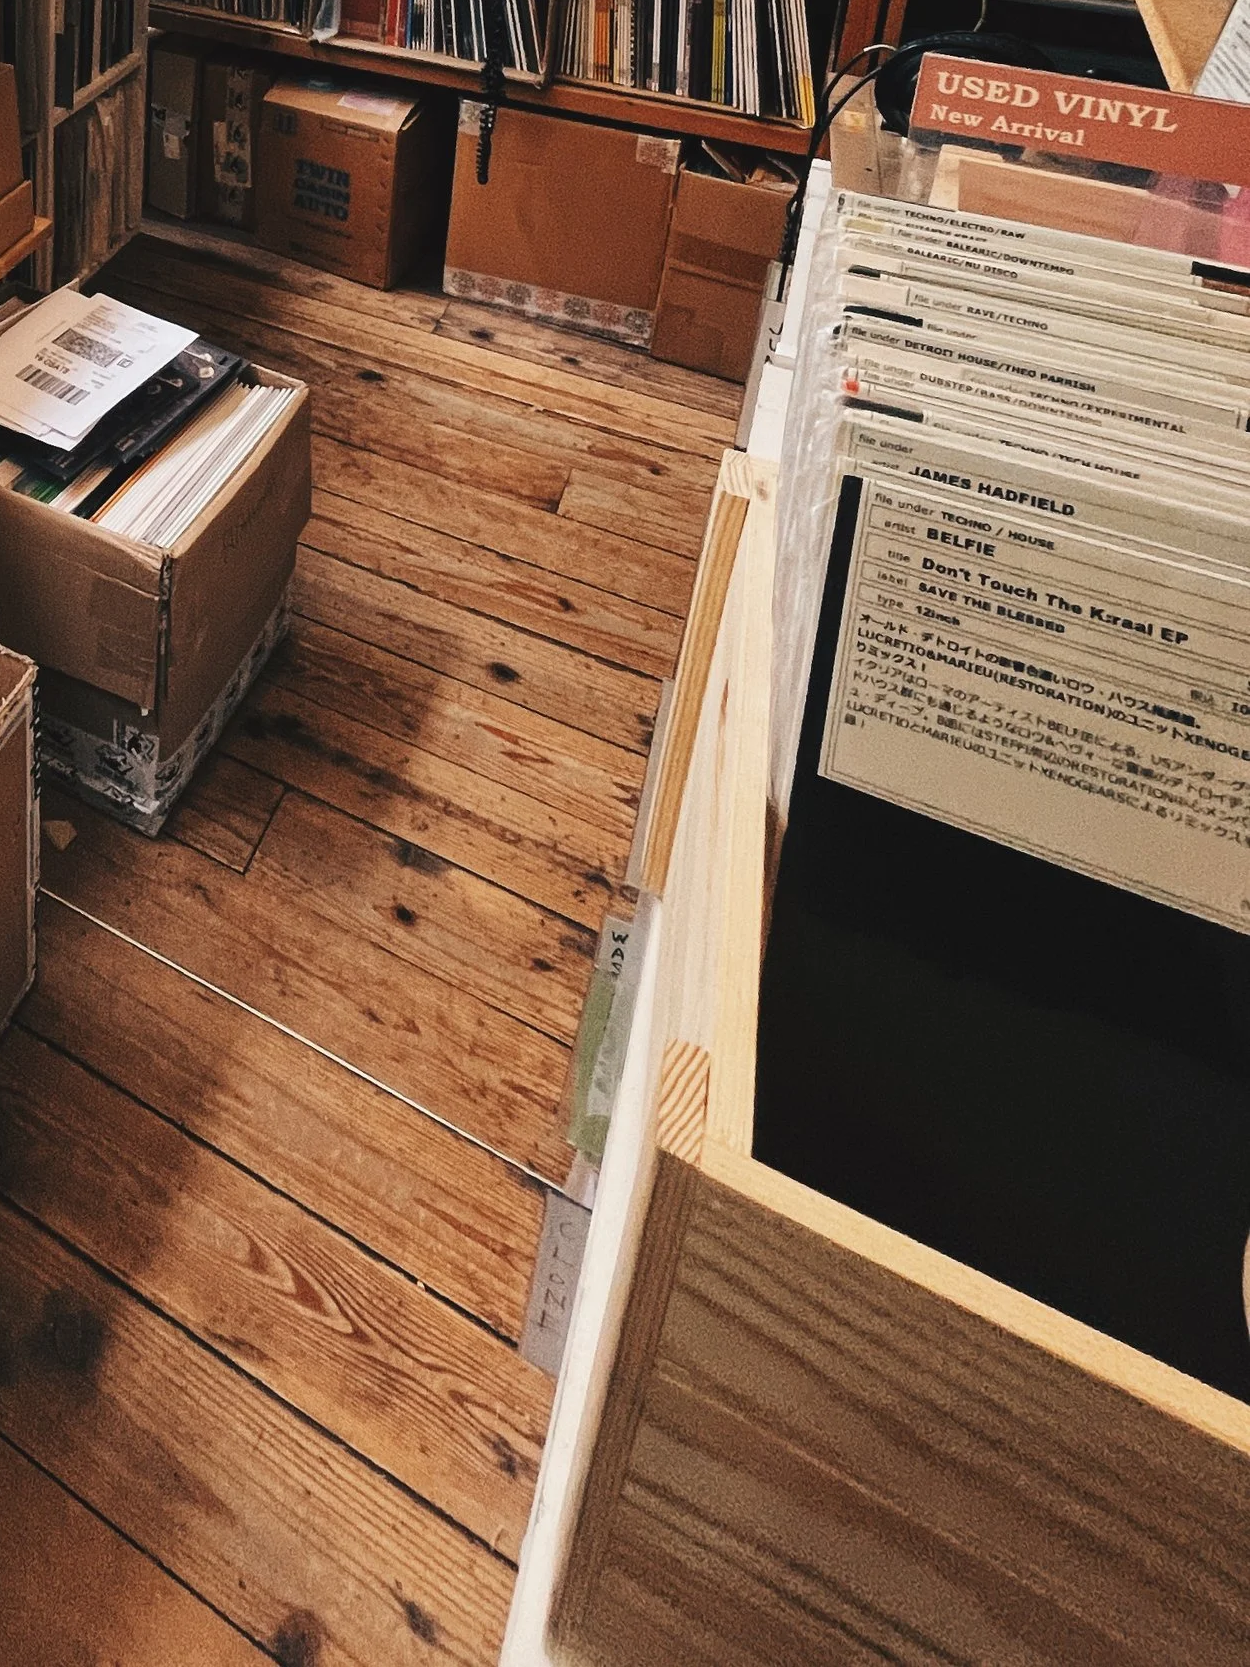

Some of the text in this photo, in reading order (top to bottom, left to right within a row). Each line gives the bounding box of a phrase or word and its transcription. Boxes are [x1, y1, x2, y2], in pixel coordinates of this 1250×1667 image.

[936, 71, 1179, 134] USED VINYL
[930, 103, 1085, 147] New Arrival
[905, 210, 1026, 240] TECHNO/ELECTRO/RAW
[907, 247, 981, 269] BALEARIC/NU
[983, 265, 1018, 279] DISCO
[946, 240, 1074, 276] BALEARIC/DOWNTEMPO
[914, 293, 1049, 331] file under RAVE/TECHNO
[851, 325, 1096, 392] file under DETROIT HOUSE/THEO PARRISH
[859, 434, 914, 454] file under
[908, 464, 972, 490] JAMES
[977, 482, 1076, 516] HADFIELD
[874, 492, 893, 507] file
[897, 498, 935, 517] under
[940, 510, 992, 534] TECHNO
[1007, 528, 1055, 550] HOUSE
[884, 519, 996, 558] artist BELFIE
[876, 569, 1066, 634] label SAVE THE BLESSED
[876, 592, 961, 626] type 12inch
[886, 548, 911, 563] title
[922, 555, 972, 582] Don't
[977, 571, 1039, 603] Touch
[1045, 592, 1084, 617] The
[1159, 624, 1190, 646] EP
